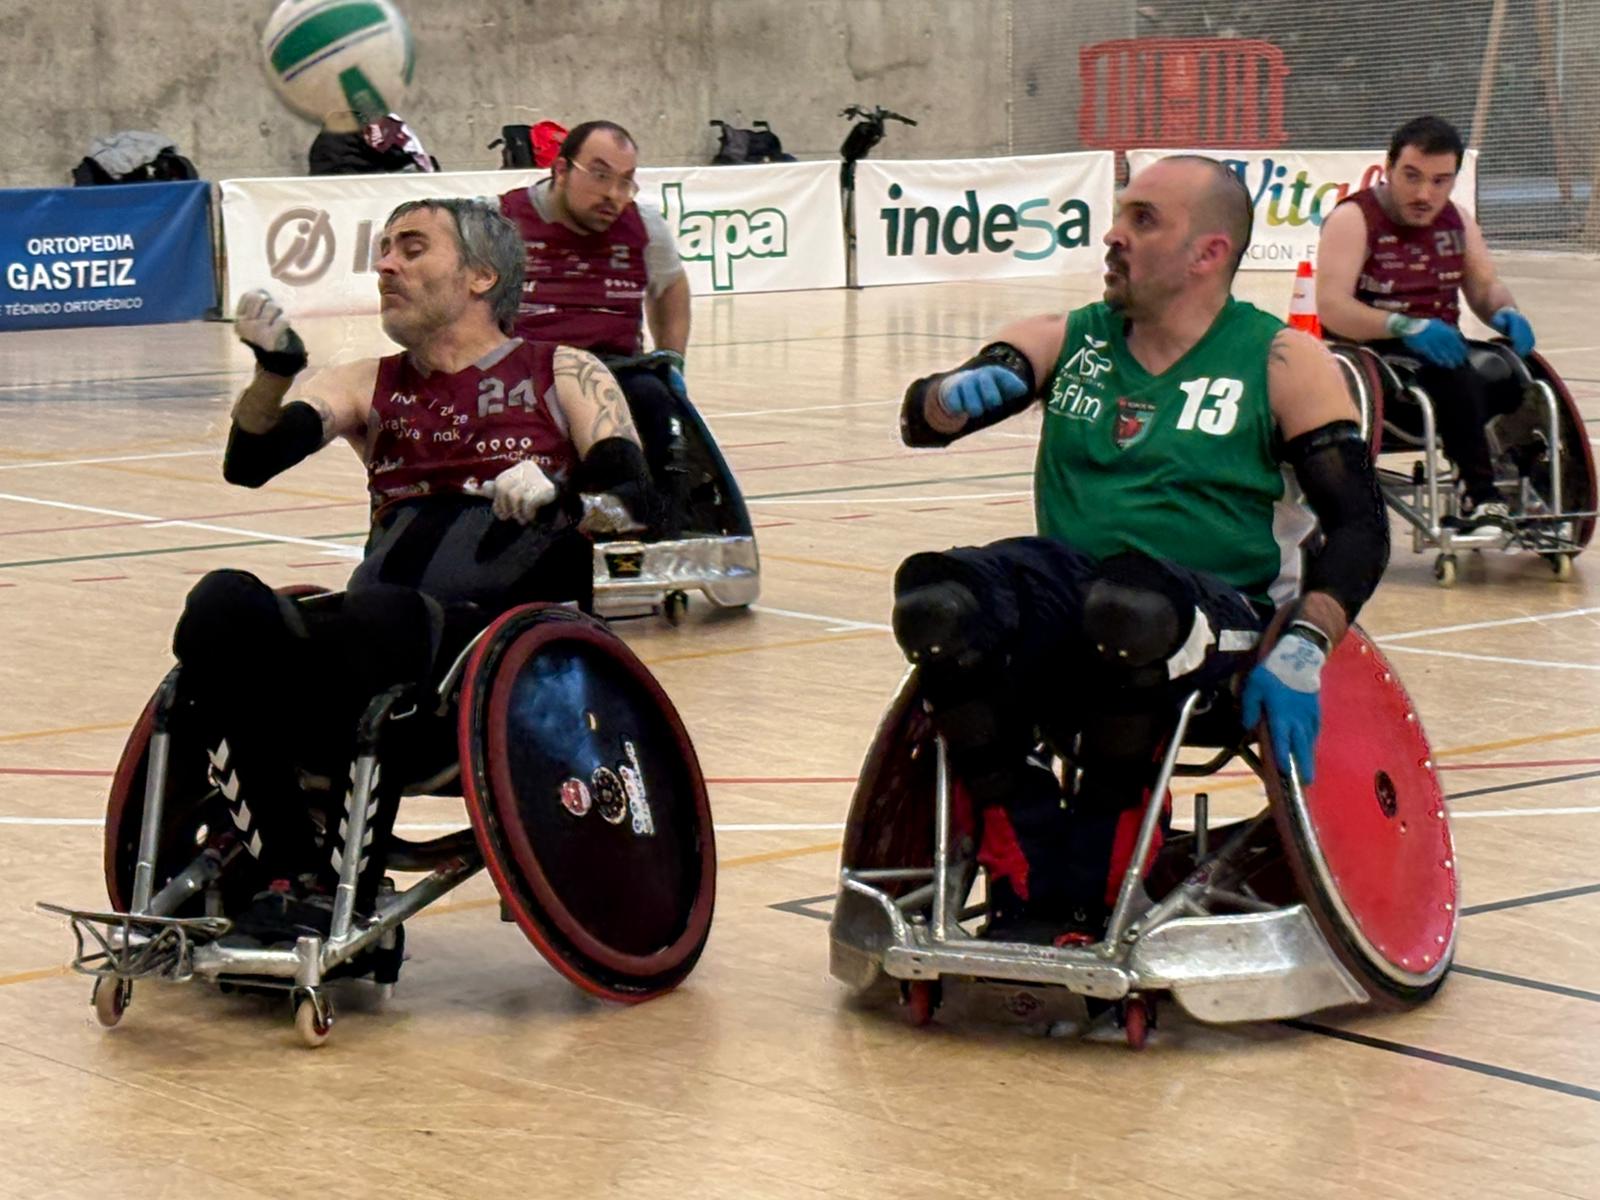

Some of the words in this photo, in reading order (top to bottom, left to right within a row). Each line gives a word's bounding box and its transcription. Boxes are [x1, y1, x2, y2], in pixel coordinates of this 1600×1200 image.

[880, 183, 1090, 261] indesa
[27, 234, 134, 255] ORTOPEDIA
[7, 258, 137, 291] GASTEIZ
[5, 303, 61, 316] TÉCNICO
[64, 297, 143, 313] ORTOPÉDICO
[477, 377, 537, 418] 24
[1176, 377, 1244, 436] 13
